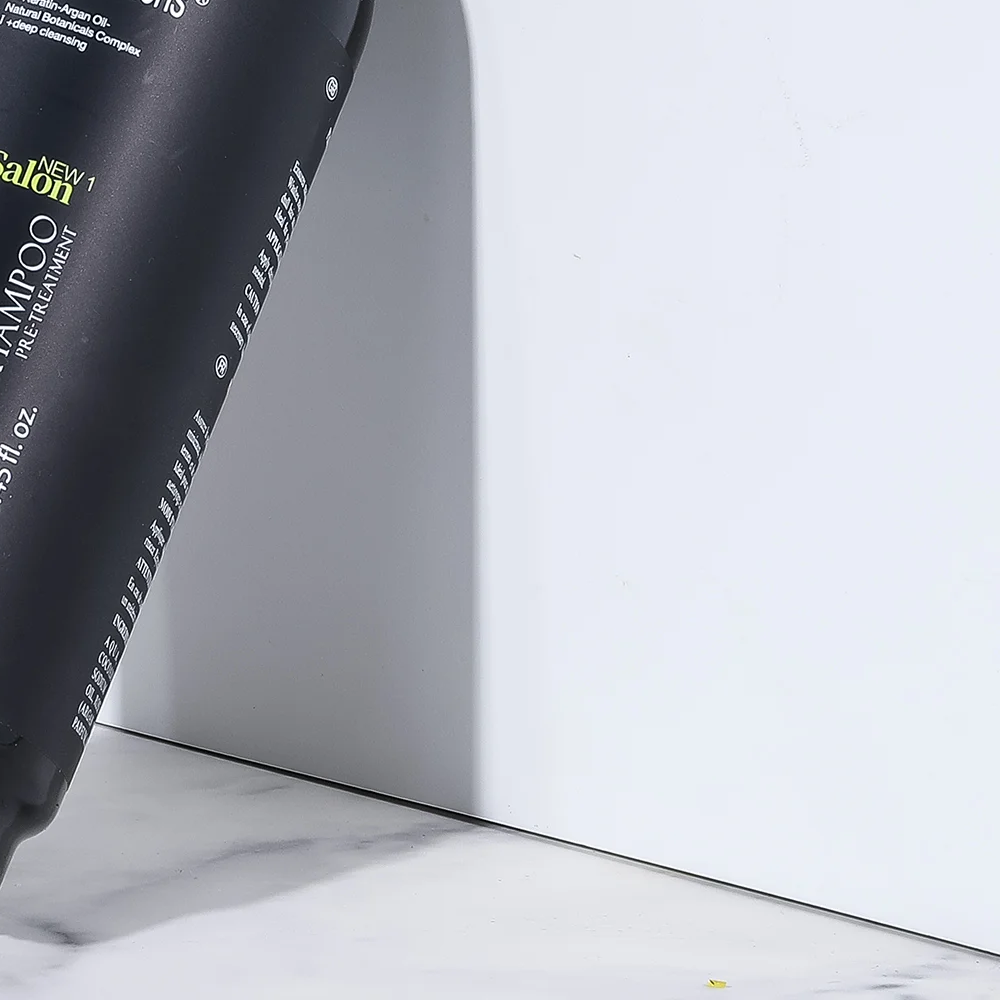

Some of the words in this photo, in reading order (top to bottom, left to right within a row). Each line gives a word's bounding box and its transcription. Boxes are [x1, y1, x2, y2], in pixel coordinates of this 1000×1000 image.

[4, 1, 42, 20] Natural
[41, 11, 95, 38] Botanicals
[95, 30, 141, 57] Complex
[39, 27, 88, 52] cleansing
[37, 155, 85, 186] NEW
[87, 176, 96, 192] 1
[14, 224, 77, 360] PRE-TREATMENT
[13, 406, 39, 439] oz.
